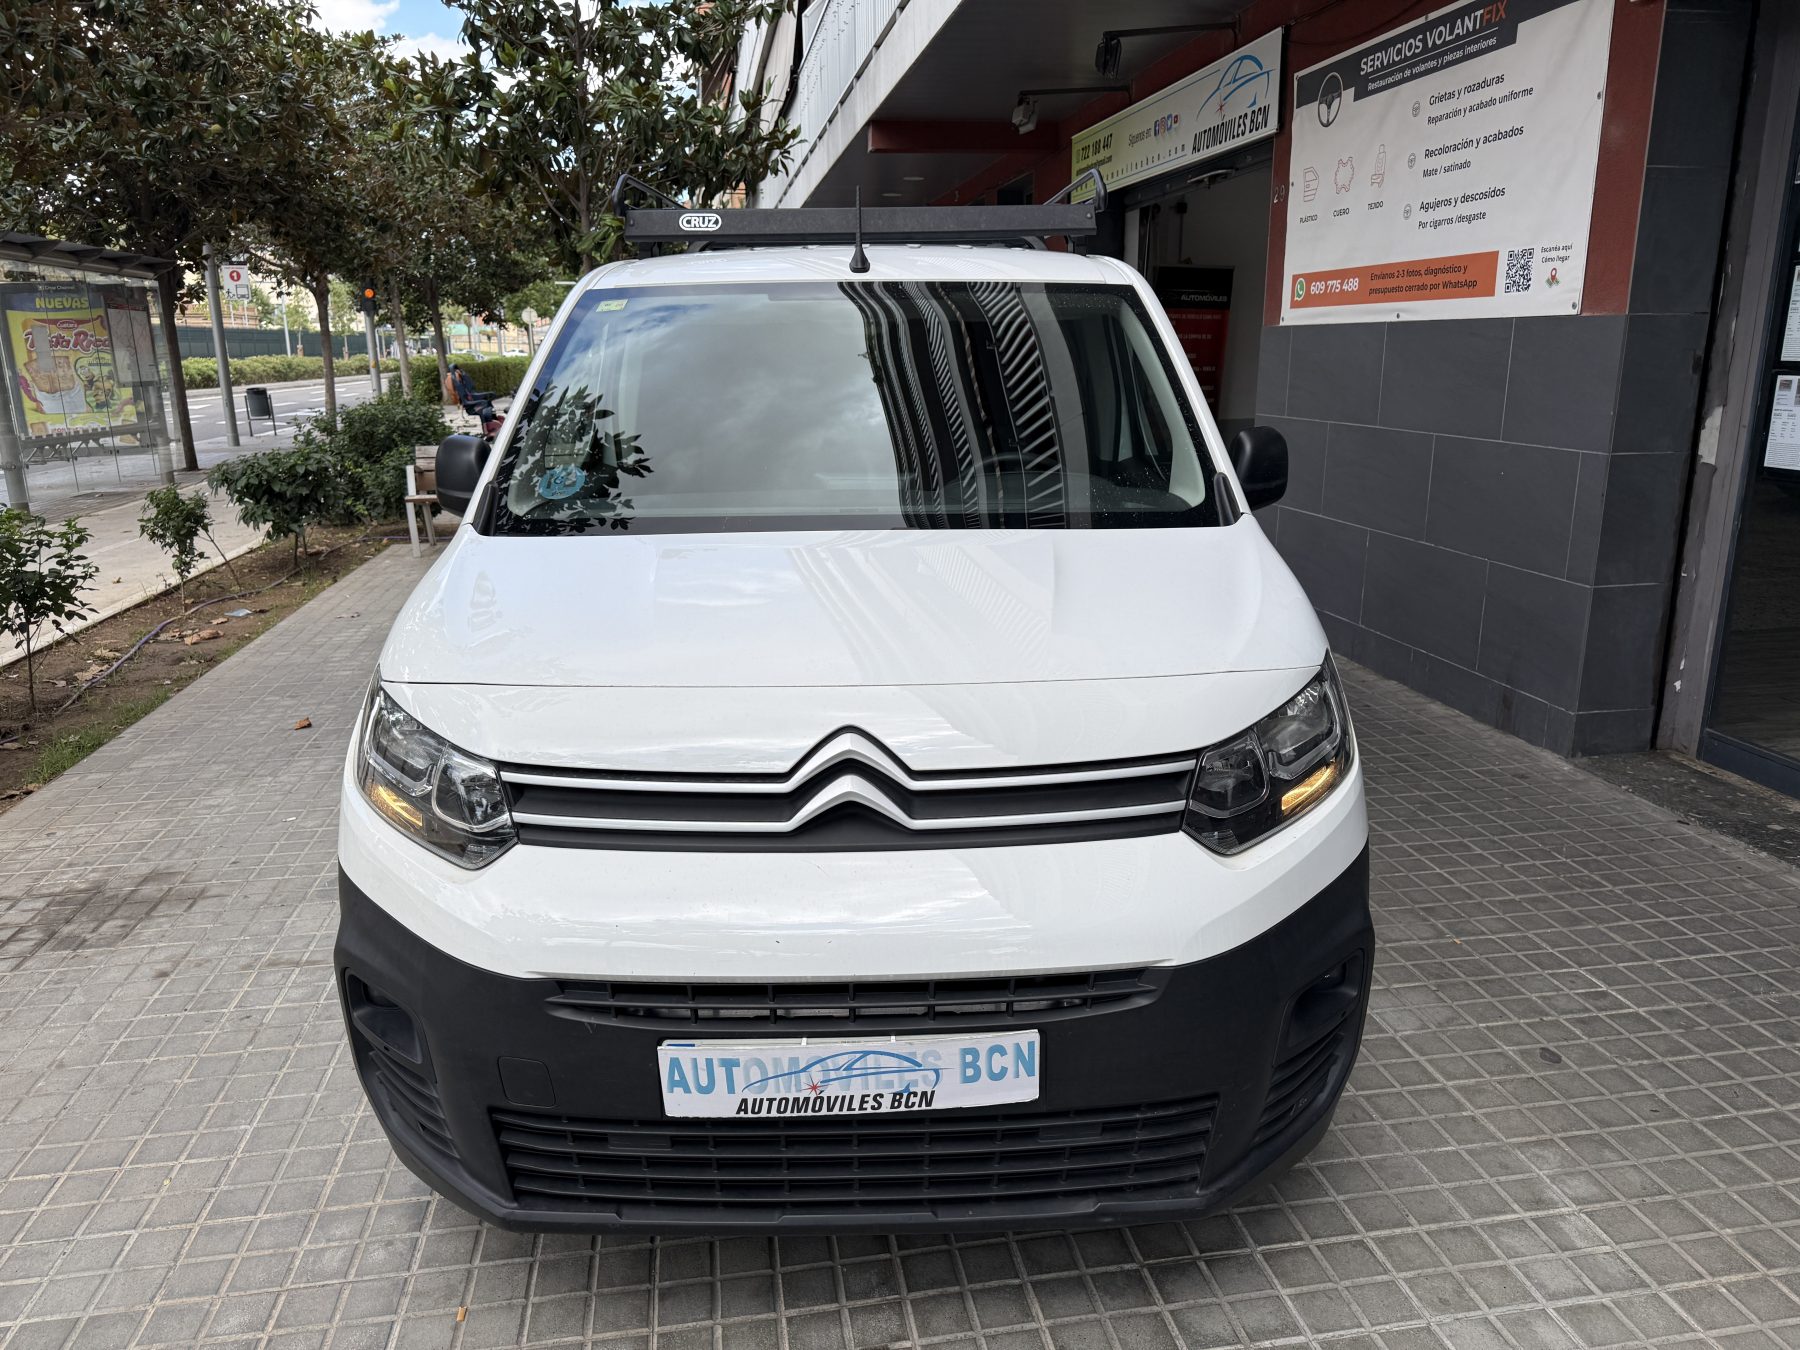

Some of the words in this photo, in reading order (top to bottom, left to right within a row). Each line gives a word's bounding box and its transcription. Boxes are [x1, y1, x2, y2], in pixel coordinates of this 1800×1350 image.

[1360, 34, 1423, 76] SERVICIOS
[1426, 0, 1508, 48] VOLANTFIX
[1367, 72, 1403, 91] Restauración
[1403, 68, 1411, 78] de
[1412, 59, 1437, 75] volantes
[1438, 57, 1443, 67] y
[1443, 48, 1463, 64] piezas
[1464, 36, 1497, 55] interiores
[1429, 89, 1456, 106] Grietas
[1456, 87, 1462, 99] y
[1463, 73, 1505, 95] rozaduras
[1427, 107, 1462, 125] Reparación
[1462, 106, 1468, 117] y
[1468, 97, 1497, 113] acabado
[1498, 87, 1534, 104] uniforme
[1191, 112, 1248, 155] AUTOMÓVILES
[1249, 104, 1270, 134] BCN
[1424, 138, 1474, 159] Recoloración
[1475, 138, 1481, 149] y
[1482, 125, 1524, 145] acabados
[1422, 168, 1438, 179] Mate
[1443, 158, 1471, 174] satinado
[1419, 198, 1452, 213] Agujeros
[1453, 196, 1459, 207] y
[1460, 186, 1506, 204] descosidos
[682, 216, 717, 228] CRUZ
[1333, 208, 1350, 218] CUERO
[1418, 219, 1428, 230] Por
[1429, 217, 1454, 230] cigarros
[1396, 270, 1405, 279] 2-3
[1424, 264, 1462, 277] diagnóstico
[1462, 265, 1468, 275] y
[1310, 281, 1325, 294] 609
[1326, 280, 1341, 294] 775
[1342, 278, 1359, 292] 488
[1368, 283, 1404, 296] presupuesto
[1404, 281, 1428, 292] cerrado
[1429, 282, 1440, 293] por
[1441, 279, 1478, 290] WhatsApp
[35, 297, 89, 309] NUEVAS
[959, 1040, 1036, 1084] BCN
[735, 1089, 885, 1115] AUTOMÓVILES
[889, 1089, 936, 1110] BCN
